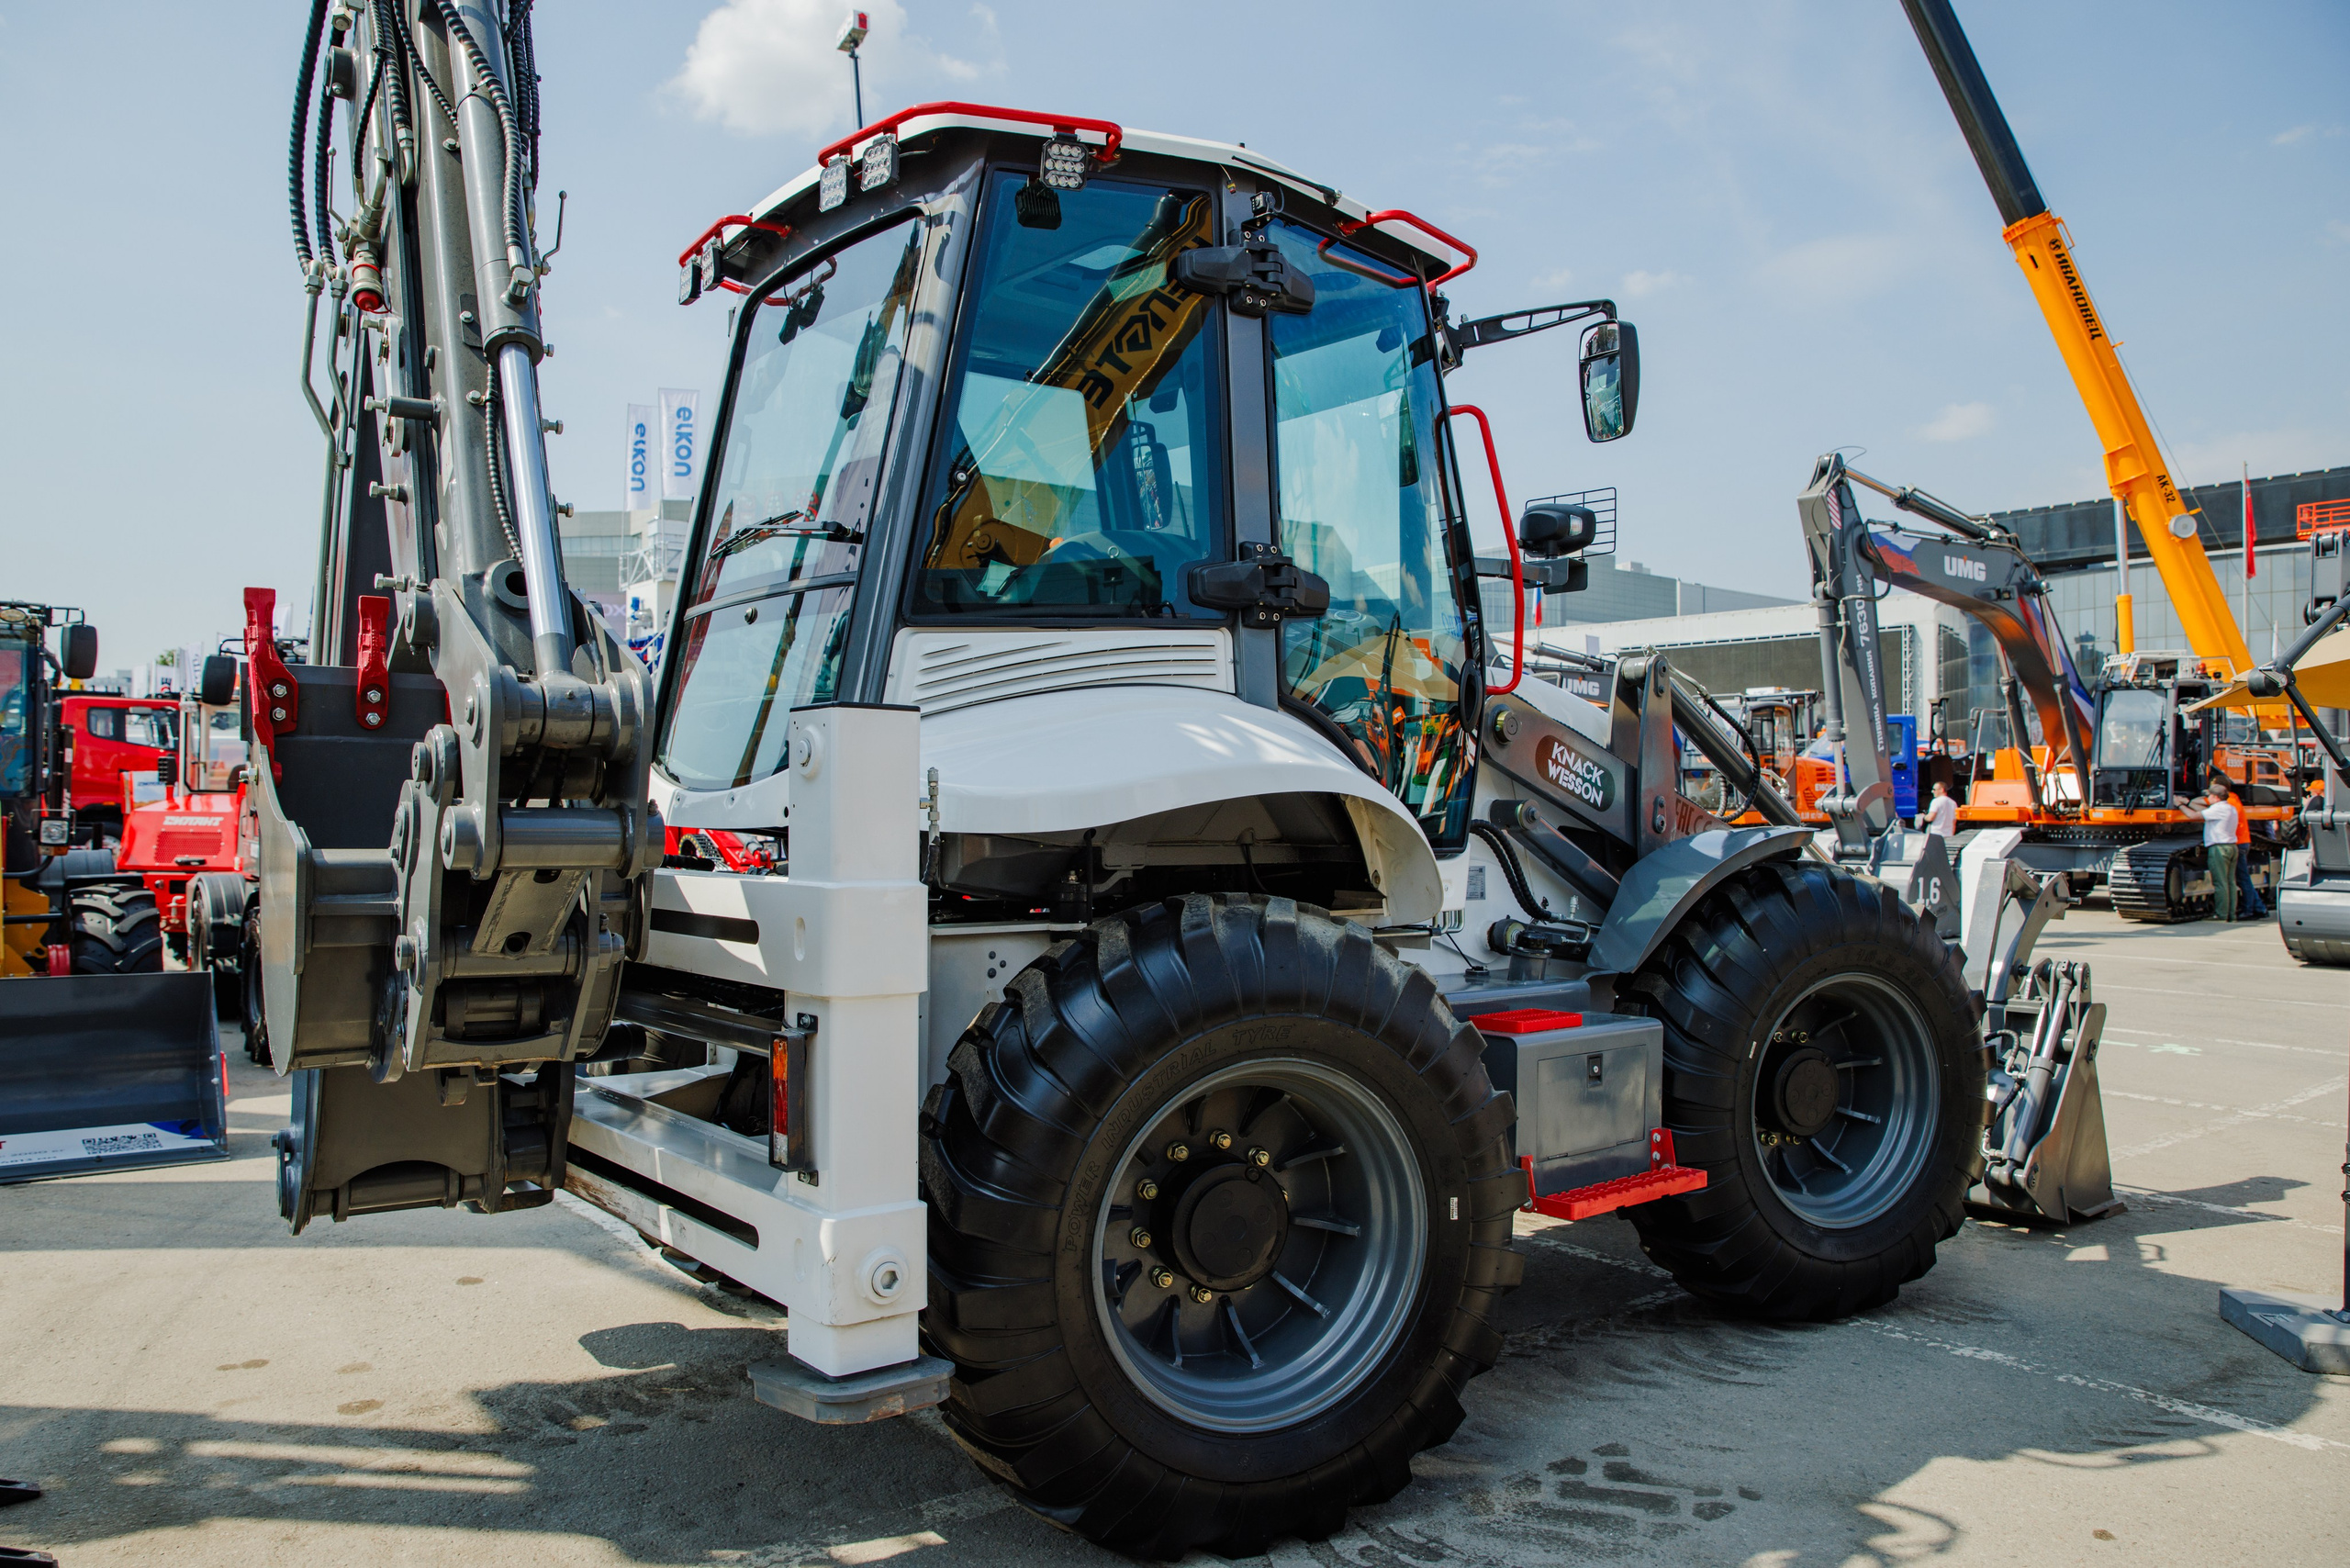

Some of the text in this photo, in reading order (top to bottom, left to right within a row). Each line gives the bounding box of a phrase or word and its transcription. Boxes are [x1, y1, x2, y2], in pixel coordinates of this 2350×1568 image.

[2055, 253, 2102, 340] ИВАНОВЕЦ
[1944, 555, 1986, 581] UMG
[1855, 599, 1870, 647] 7630
[1562, 677, 1600, 696] UMG
[1548, 759, 1604, 807] WESSON
[1551, 741, 1605, 787] KNACK
[1917, 877, 1942, 907] 1,6
[1065, 1025, 1292, 1251] POWER INDUSTRIAL TYRE
